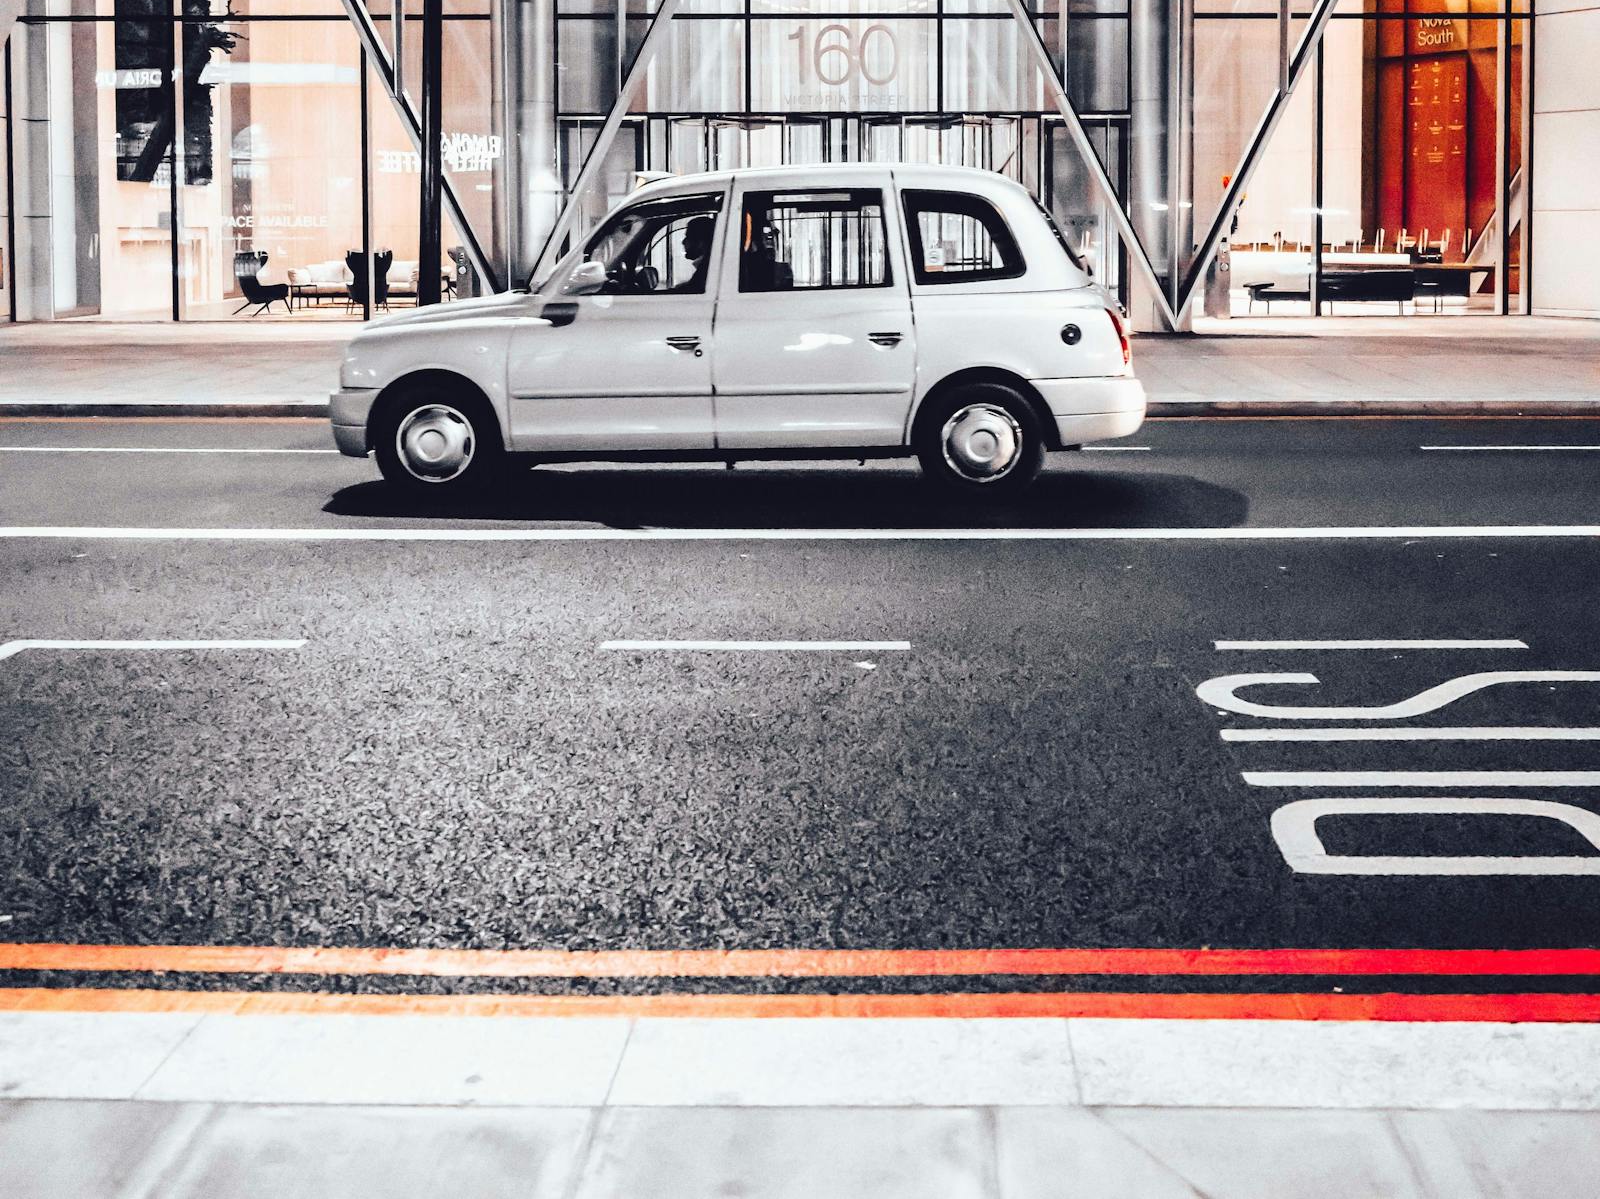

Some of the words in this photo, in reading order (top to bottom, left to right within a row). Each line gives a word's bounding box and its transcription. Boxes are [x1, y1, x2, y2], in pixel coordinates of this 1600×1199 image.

[1419, 18, 1451, 28] Nova
[1417, 29, 1454, 46] South
[788, 24, 899, 86] 160
[784, 95, 847, 105] VICTORIA
[219, 215, 255, 228] PACE
[259, 215, 329, 228] AVAILABLE
